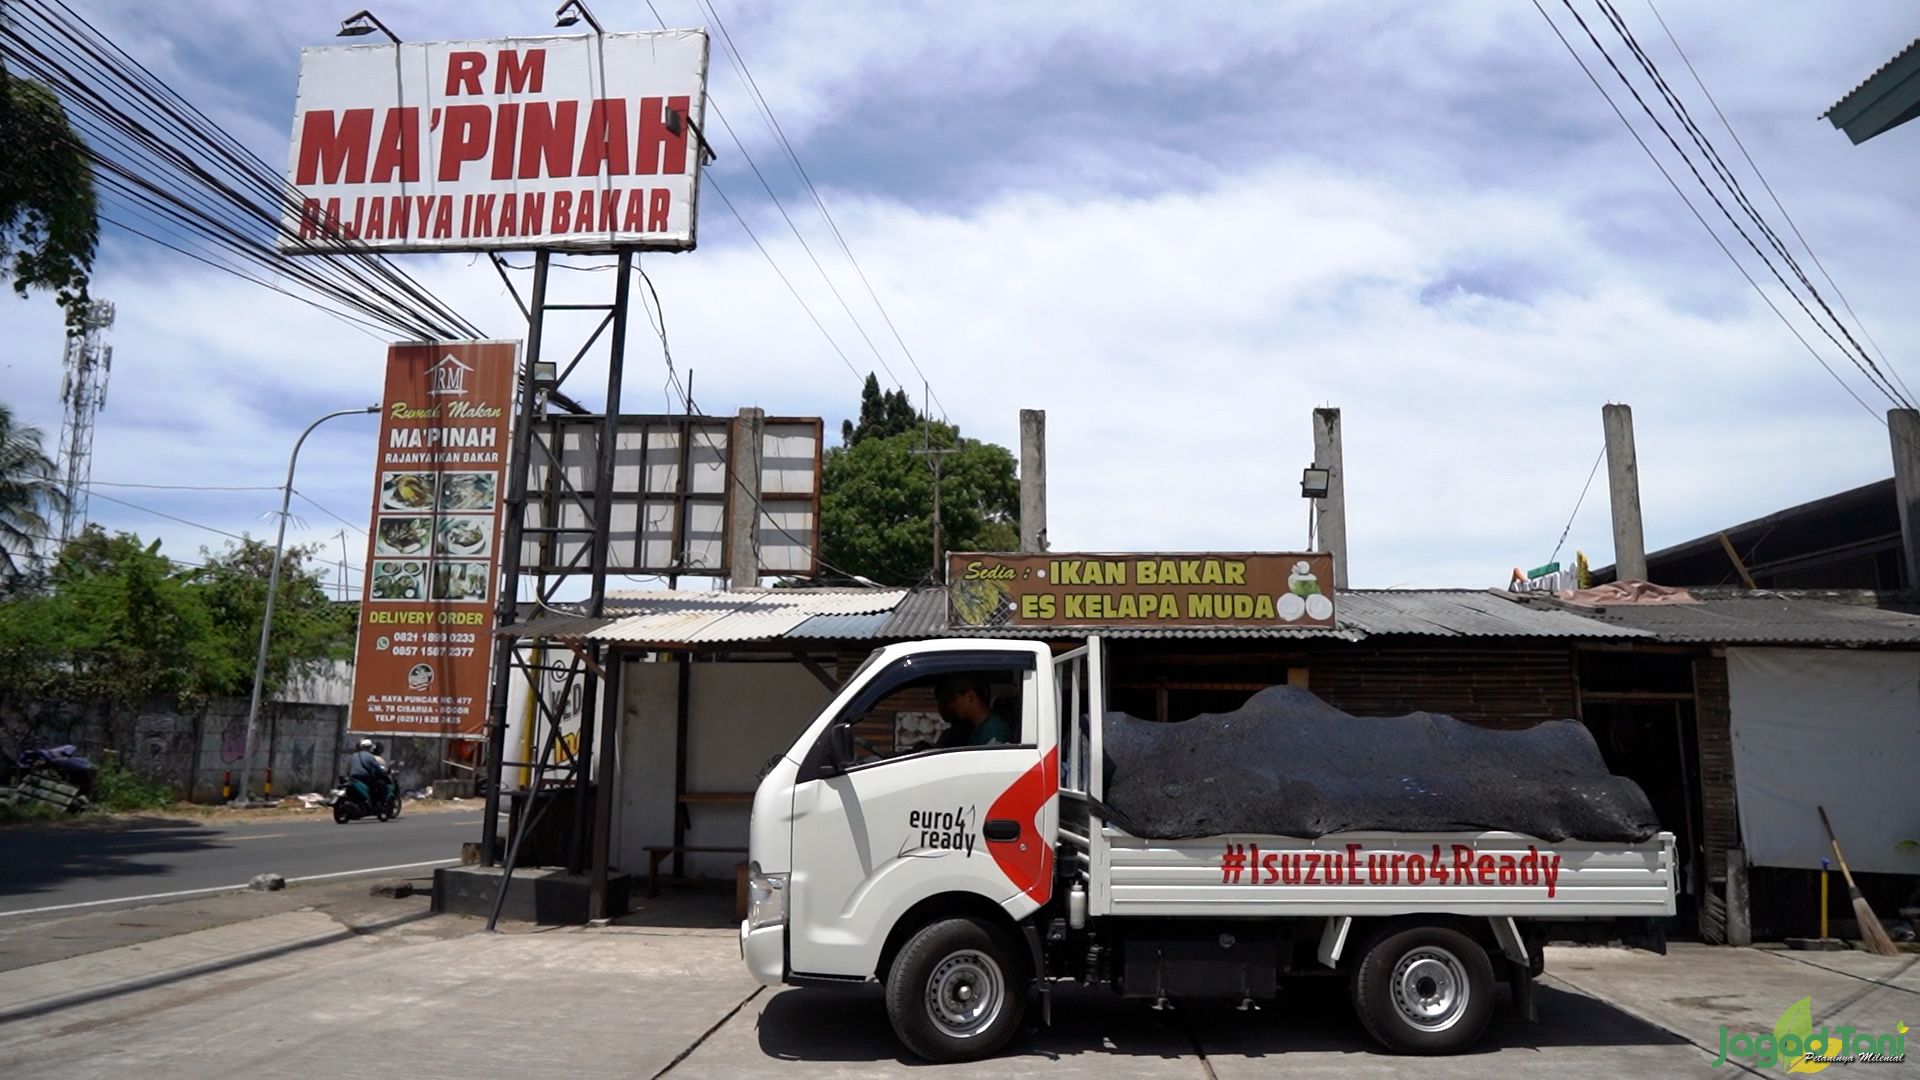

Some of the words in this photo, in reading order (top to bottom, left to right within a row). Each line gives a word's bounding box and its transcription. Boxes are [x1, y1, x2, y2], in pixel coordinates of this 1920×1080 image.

[445, 49, 546, 96] RM
[295, 95, 691, 185] MA'PINAH
[299, 194, 453, 240] RAJANYA
[460, 192, 545, 238] IKAN
[551, 188, 671, 234] BAKAR
[436, 367, 461, 390] RM
[390, 402, 441, 420] Rumah
[448, 401, 502, 418] Makan
[389, 427, 496, 448] MA'PINAH
[385, 452, 432, 464] RAJANYA
[434, 452, 460, 463] IKAN
[463, 452, 499, 463] BAKAR
[963, 561, 1016, 581] Sedia
[1049, 560, 1128, 586] IKAN
[1136, 560, 1246, 585] BAKAR
[1020, 594, 1056, 619] ES
[1064, 593, 1180, 619] KELAPA
[1187, 594, 1276, 619] MUDA
[369, 612, 434, 624] DELIVERY
[438, 612, 484, 625] ORDER
[396, 705, 433, 713] CISARUA
[404, 696, 439, 704] PUNCAK
[909, 806, 966, 830] euro4
[920, 829, 976, 858] ready
[1220, 843, 1561, 898] #IsuzuEuro4Ready
